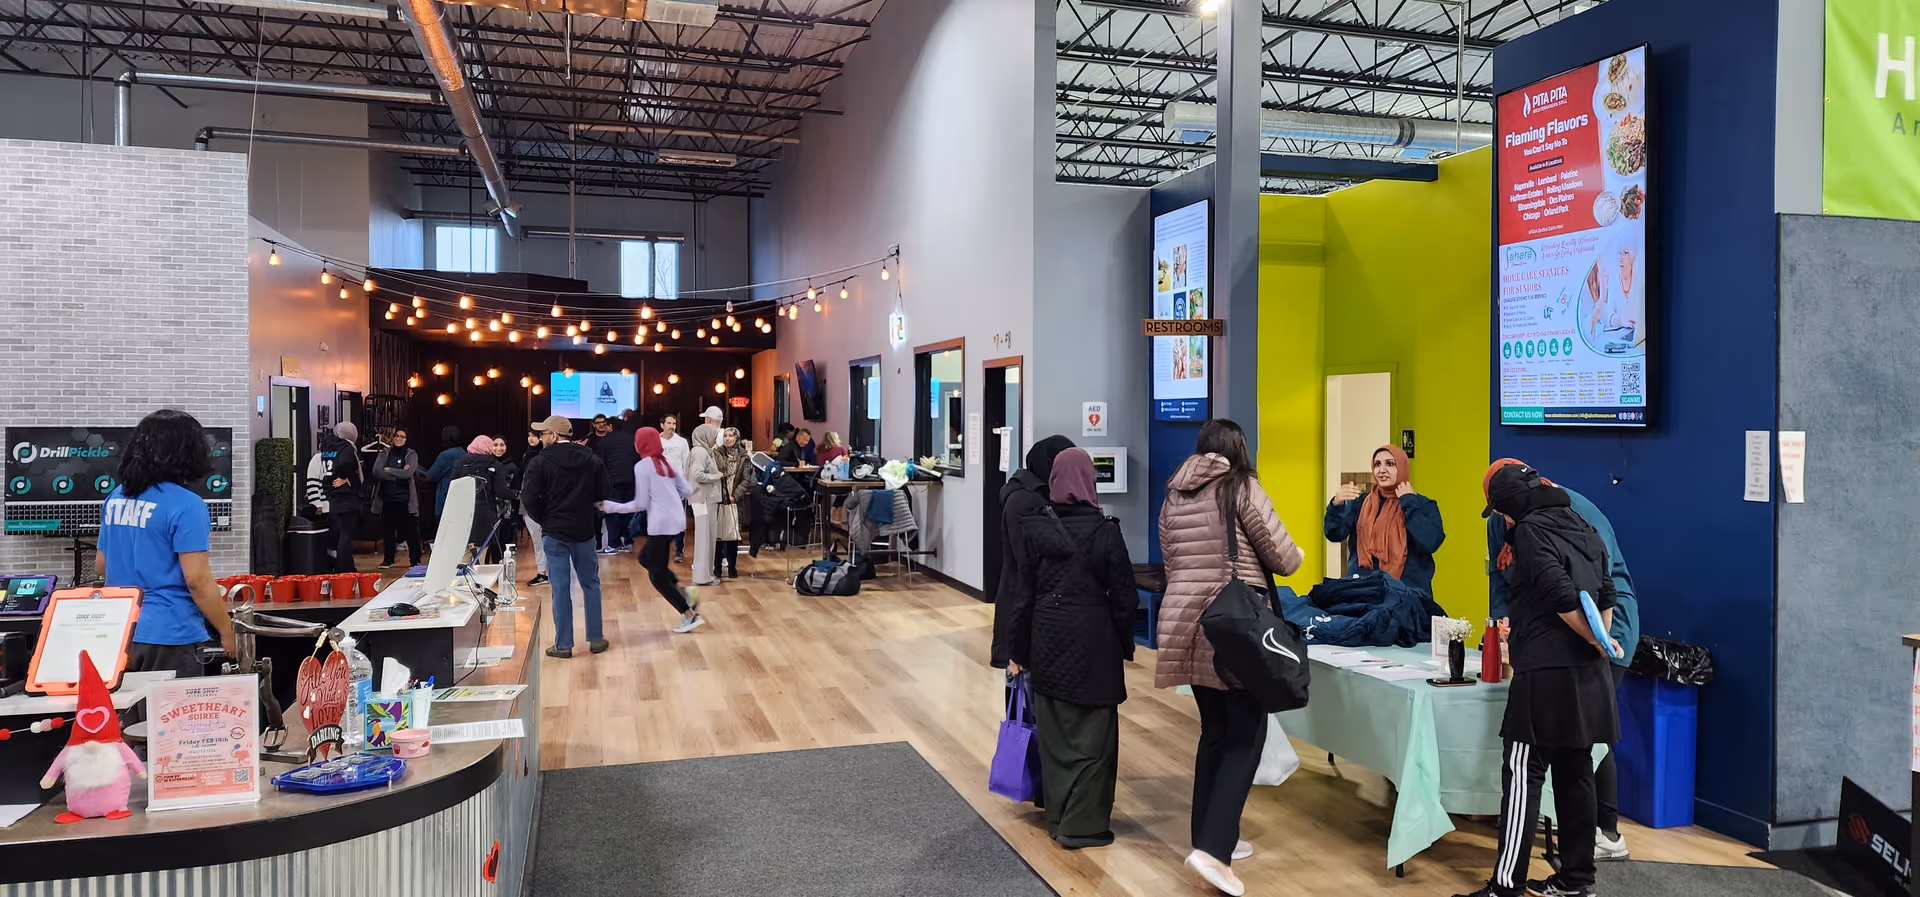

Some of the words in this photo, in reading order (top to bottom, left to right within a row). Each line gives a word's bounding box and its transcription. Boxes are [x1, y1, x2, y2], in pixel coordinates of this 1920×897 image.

[1875, 32, 1916, 101] H
[1532, 92, 1549, 108] PITA
[1550, 86, 1568, 103] PITA
[1505, 126, 1546, 148] Flaming
[1547, 114, 1589, 136] Flavors
[1533, 145, 1545, 154] Can't
[1545, 142, 1554, 151] Say
[1554, 140, 1561, 148] No
[1514, 180, 1535, 191] Naperville
[1538, 174, 1557, 186] Lombard
[1560, 169, 1579, 180] Palatine
[1510, 193, 1528, 202] Hoffman
[1528, 189, 1543, 199] Estates
[1547, 185, 1561, 195] Rolling
[1562, 180, 1584, 191] Meadows
[1517, 199, 1546, 211] Bloomingdale
[1549, 196, 1559, 205] Des
[1559, 193, 1574, 203] Plaines
[1523, 211, 1541, 221] Chicago
[1544, 206, 1559, 216] Orland
[1559, 204, 1569, 213] Park
[1504, 246, 1533, 271] Sahara
[1503, 272, 1521, 284] HOME
[1521, 270, 1538, 281] CARE
[1538, 266, 1570, 279] SERVICES
[1503, 285, 1515, 296] FOR
[1515, 282, 1542, 294] SENIORS
[1146, 321, 1222, 333] RESTROOMS
[1620, 396, 1632, 404] SCAN
[1503, 411, 1525, 419] CONTACT
[39, 446, 109, 458] DrillPickle
[104, 498, 157, 529] STAFF
[185, 687, 202, 695] SURE
[160, 702, 246, 724] SWEETHEART
[188, 712, 220, 721] SOIREE
[311, 706, 338, 730] LOVE
[311, 727, 340, 750] DARLING
